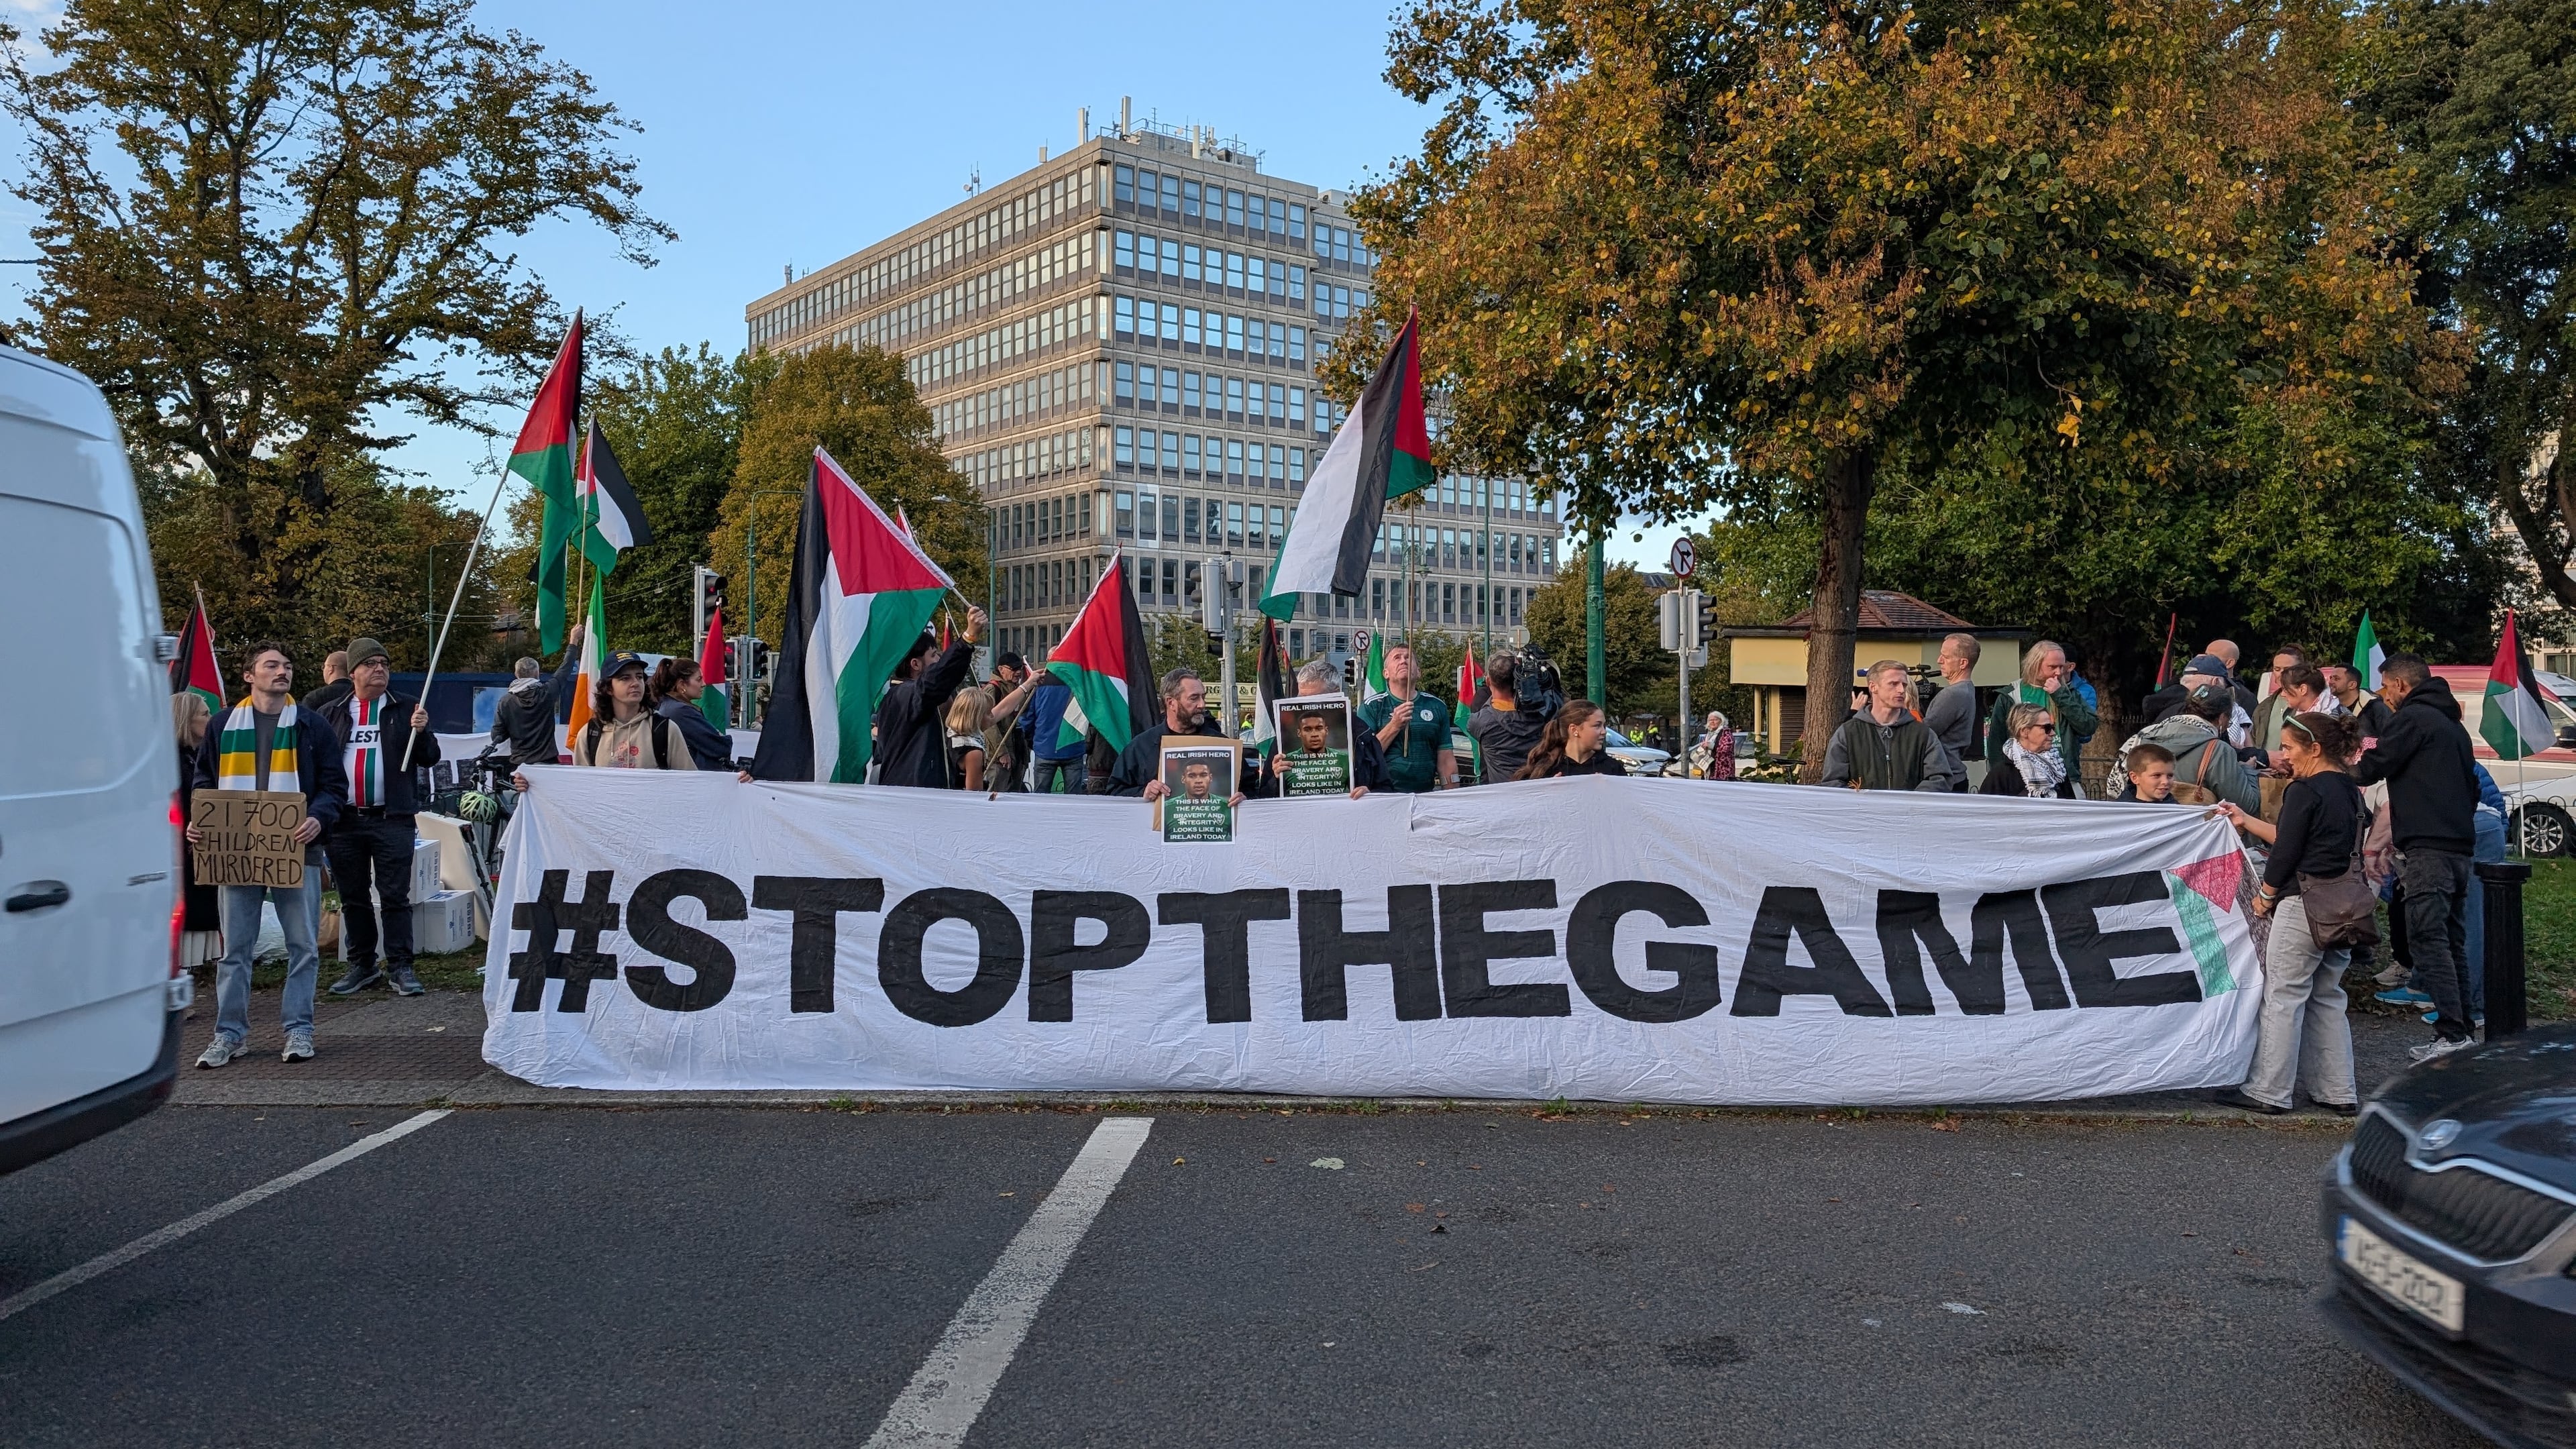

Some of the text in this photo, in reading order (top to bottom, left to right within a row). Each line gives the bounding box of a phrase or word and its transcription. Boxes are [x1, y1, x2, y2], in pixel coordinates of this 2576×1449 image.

[1239, 686, 1248, 694] &
[347, 731, 380, 743] LEST
[194, 831, 297, 853] CHILDREN
[195, 853, 302, 885] MURDERED
[508, 869, 2202, 1028] #STOPTHEGAME
